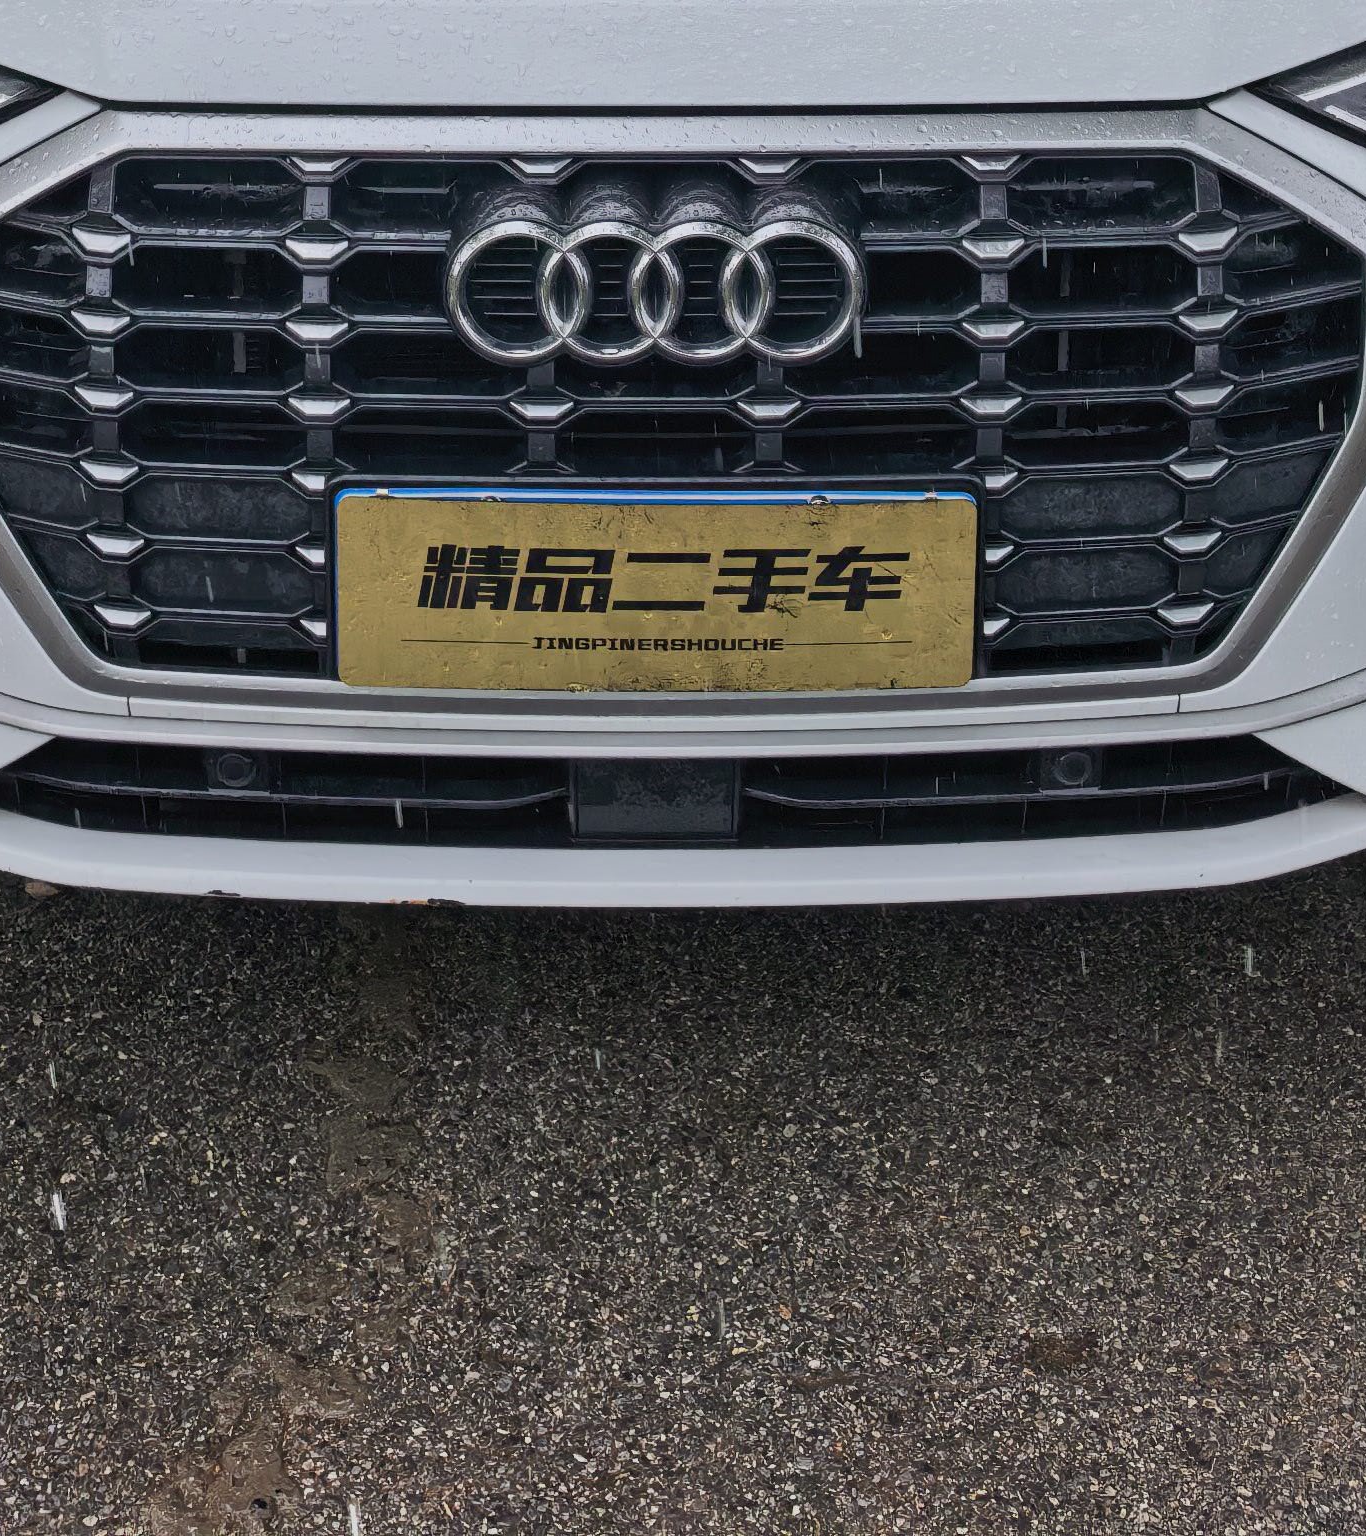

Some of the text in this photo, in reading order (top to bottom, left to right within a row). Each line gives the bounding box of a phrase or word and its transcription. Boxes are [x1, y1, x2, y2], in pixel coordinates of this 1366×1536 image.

[416, 544, 912, 614] 精品二手车
[530, 635, 785, 652] JINGPINERSHOUCHE
